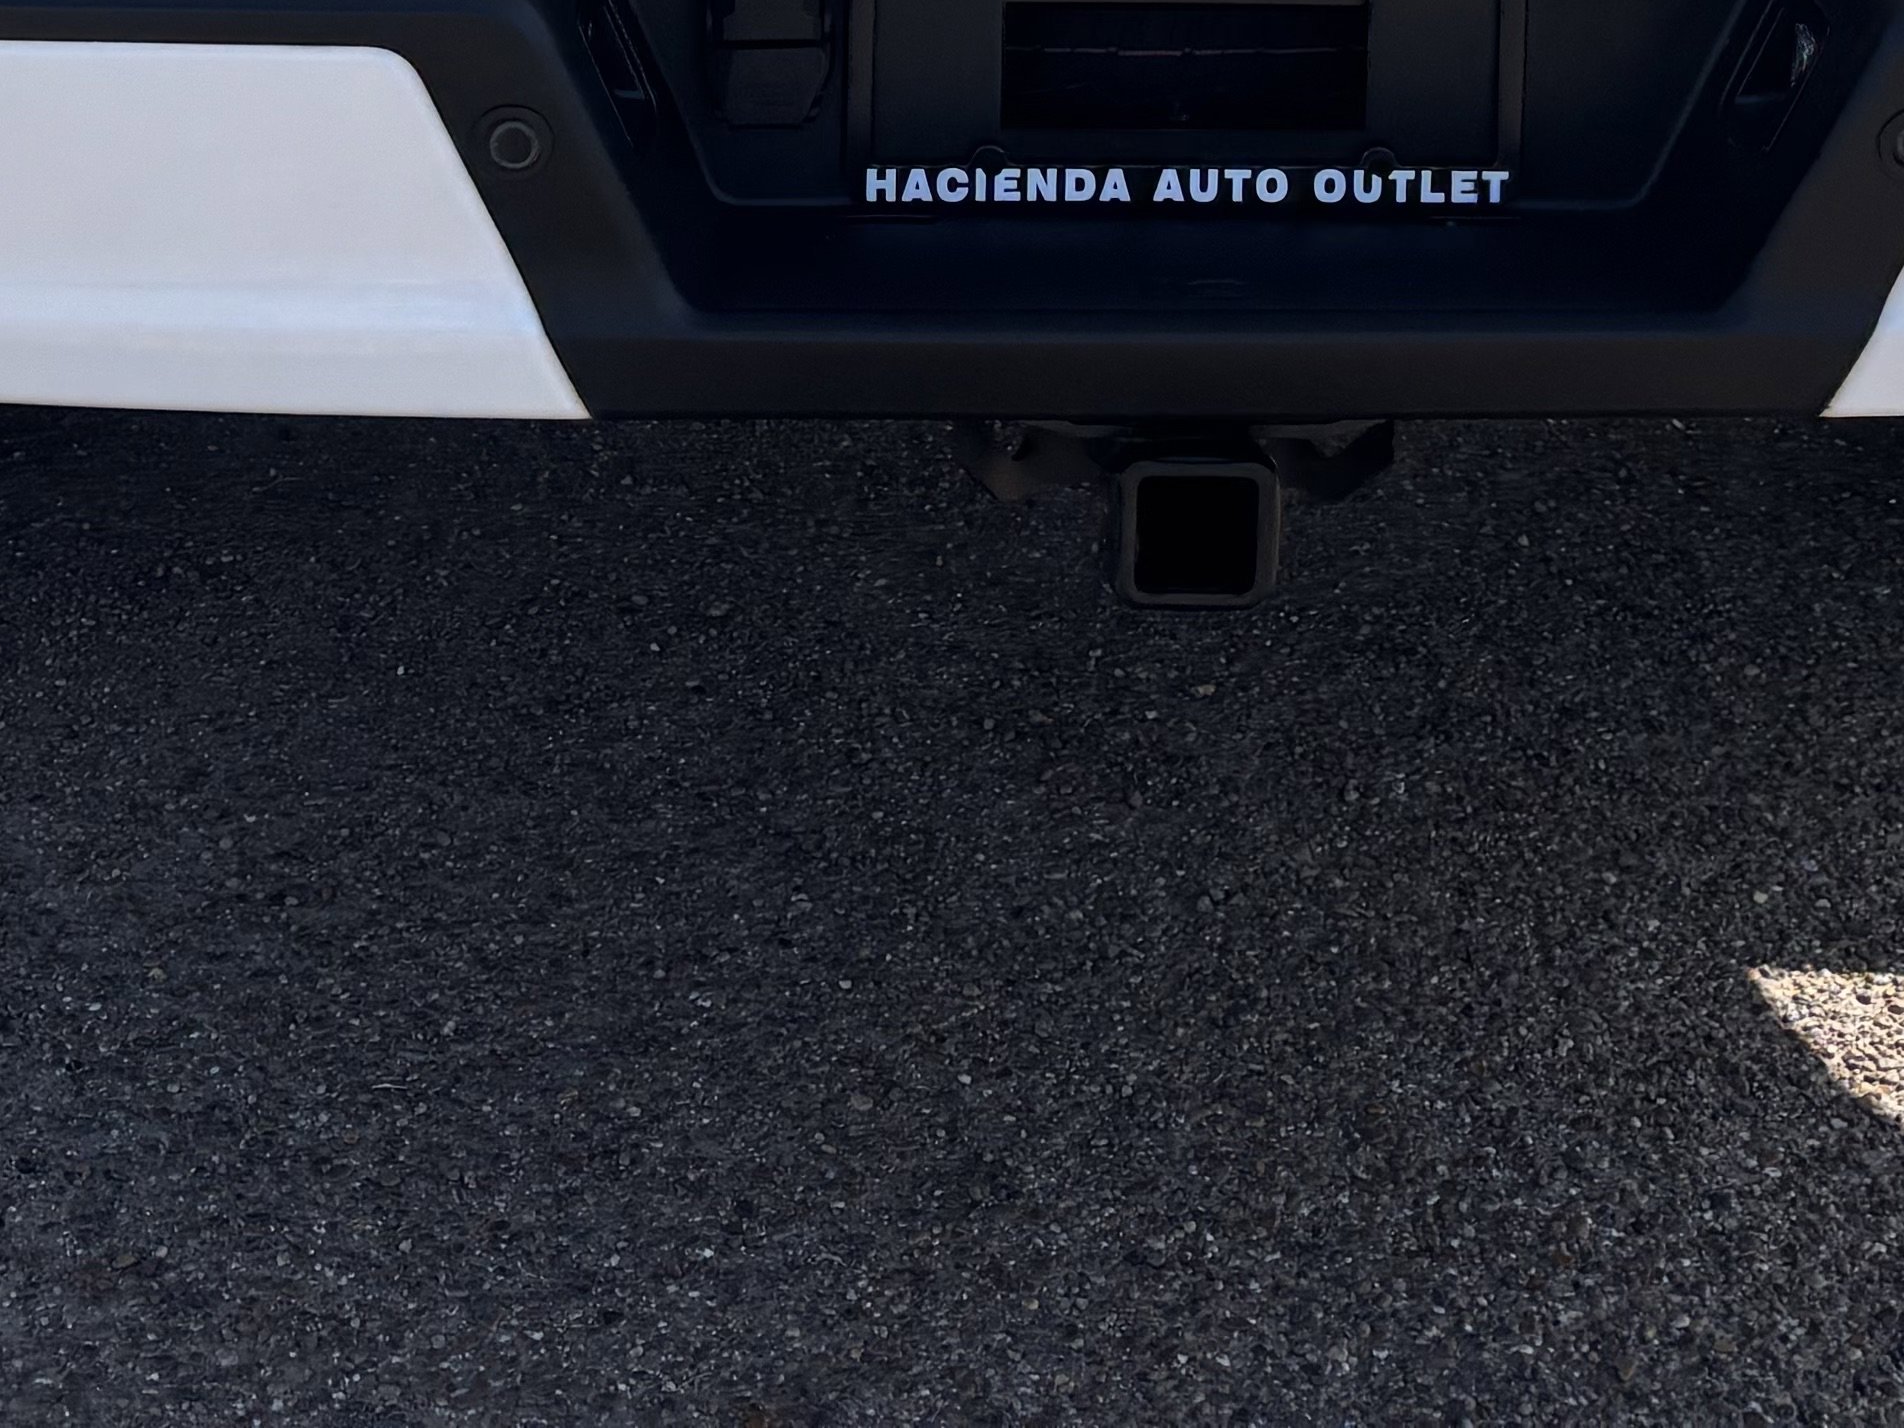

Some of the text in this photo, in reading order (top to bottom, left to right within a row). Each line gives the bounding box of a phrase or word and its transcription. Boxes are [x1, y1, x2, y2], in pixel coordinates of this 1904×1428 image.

[866, 167, 1510, 204] HACIENDA AUTO OUTLET
